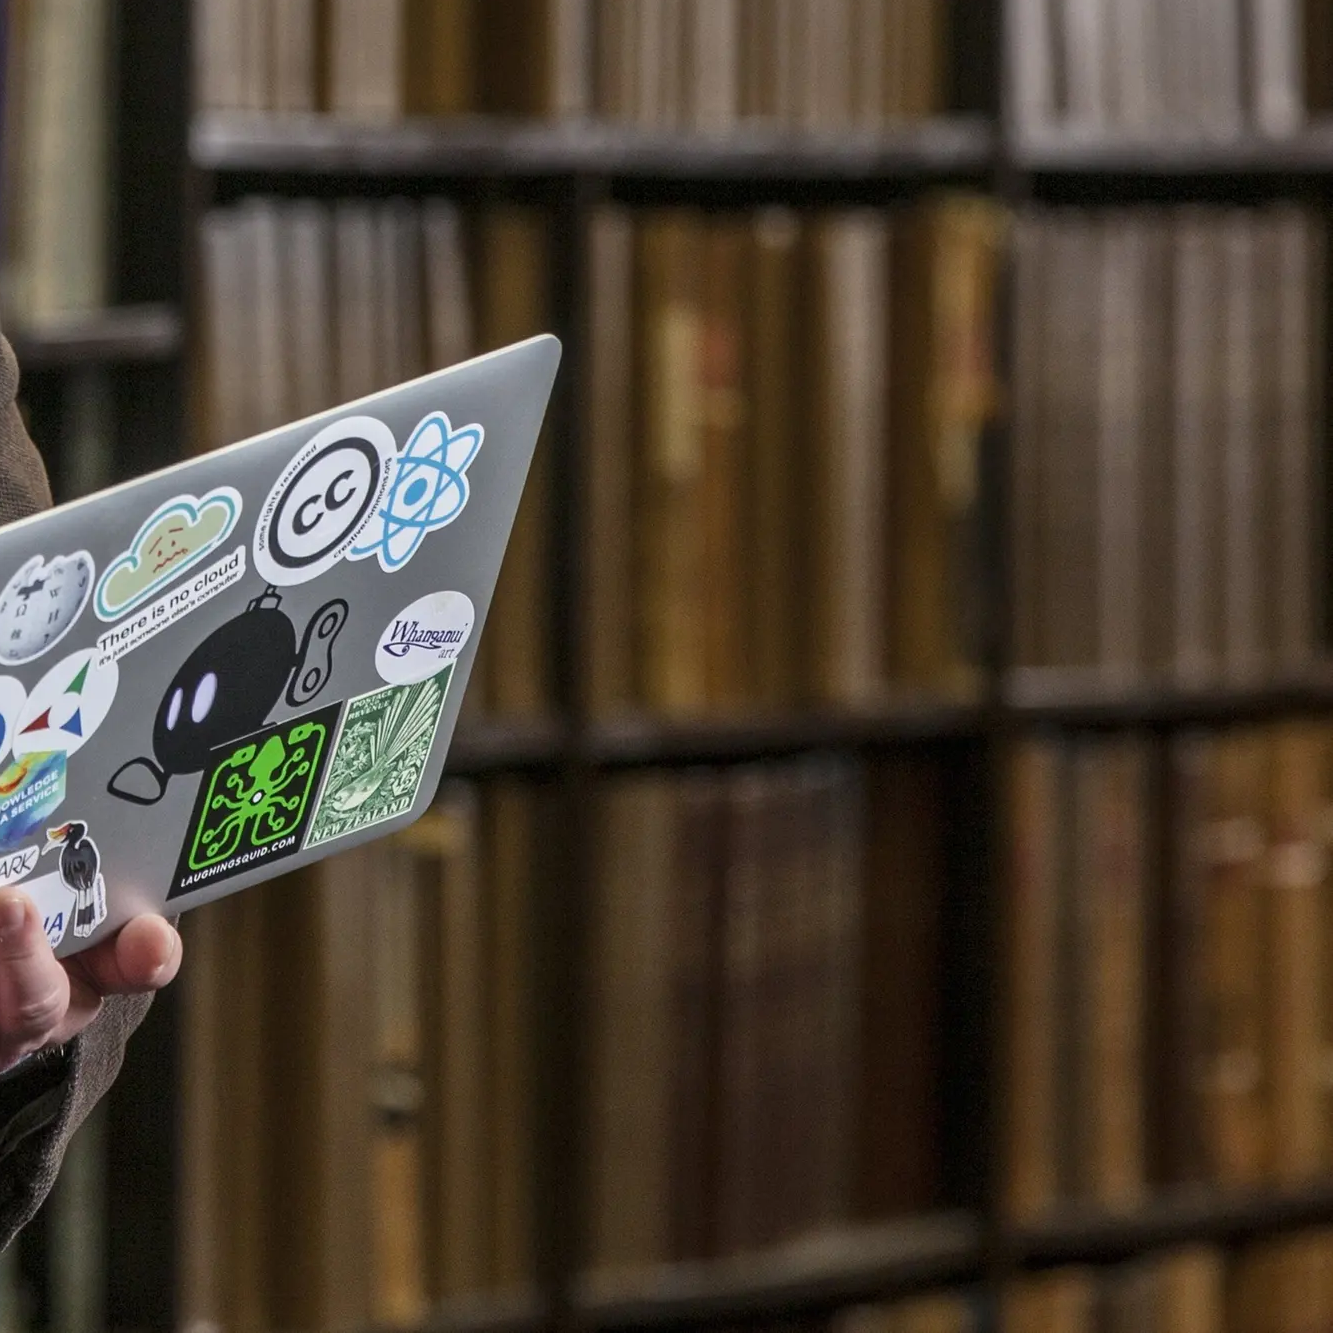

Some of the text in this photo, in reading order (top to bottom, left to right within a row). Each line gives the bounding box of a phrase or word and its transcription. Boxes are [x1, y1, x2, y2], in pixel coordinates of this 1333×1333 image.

[258, 443, 318, 551] some rights reserved
[333, 457, 392, 559] creativecommons.org
[99, 553, 239, 651] There is no cloud
[112, 642, 128, 660] just
[130, 616, 170, 646] someone
[171, 599, 196, 620] else's
[196, 570, 239, 603] computer
[390, 620, 468, 644] Whanganui
[437, 646, 455, 659] art
[347, 699, 392, 721] REVENUE
[352, 688, 394, 709] POSTAGE
[0, 813, 9, 825] A
[10, 781, 59, 818] SERVICE
[310, 797, 410, 843] NEW ZEALAND
[180, 835, 296, 888] LAUGHINGSQUID.COM
